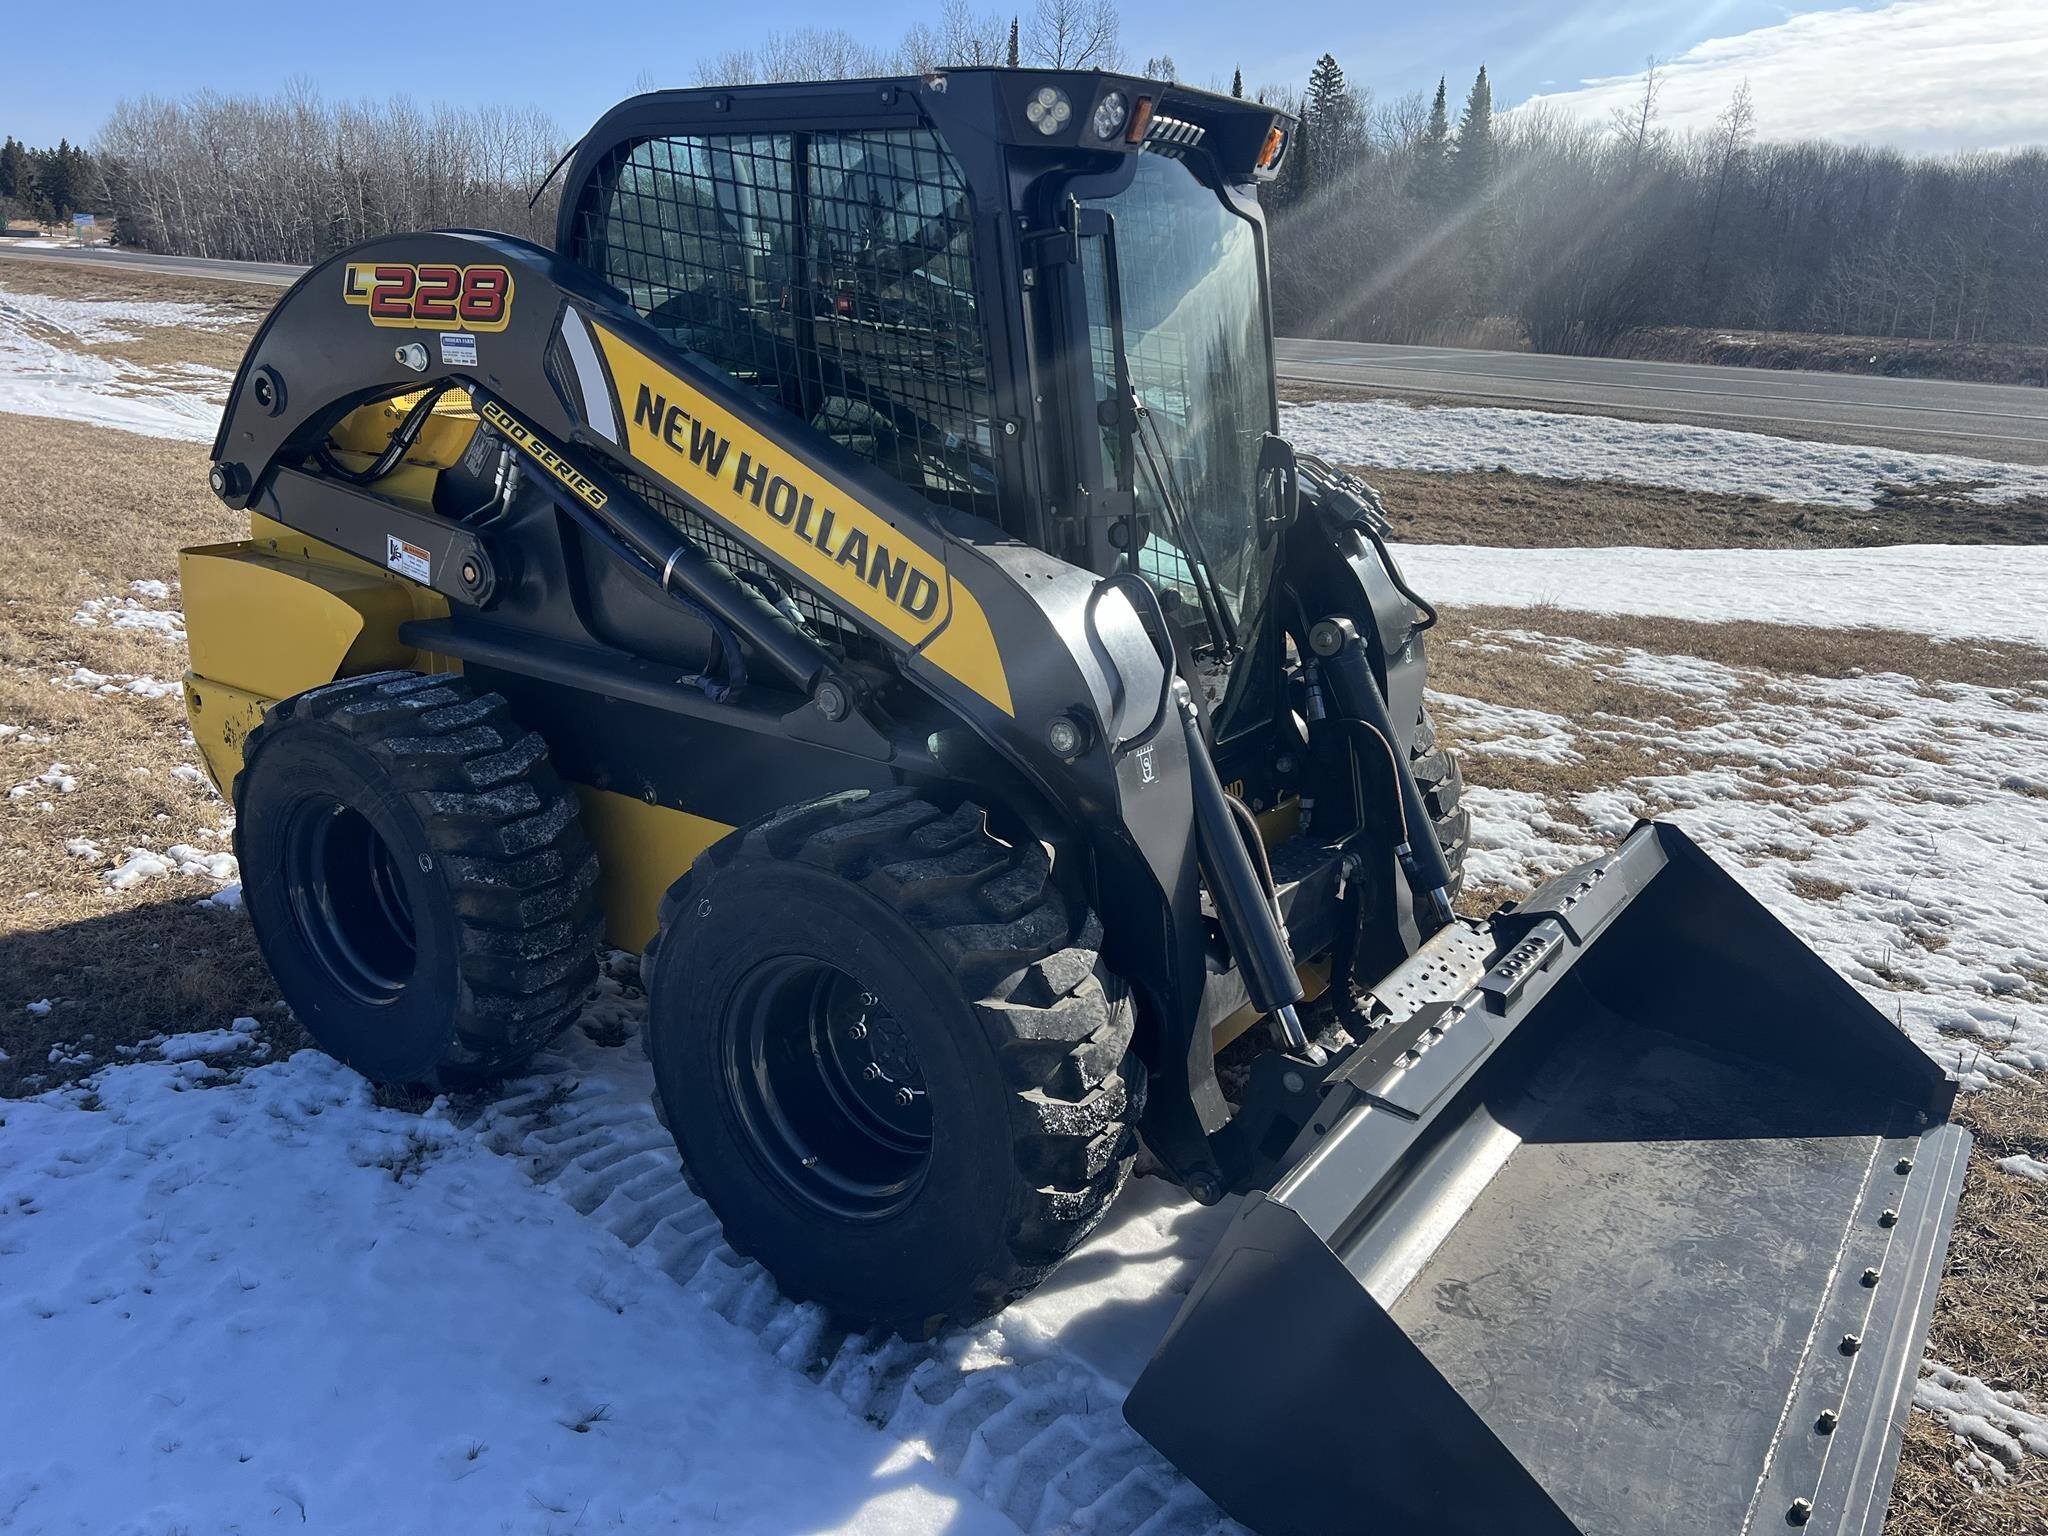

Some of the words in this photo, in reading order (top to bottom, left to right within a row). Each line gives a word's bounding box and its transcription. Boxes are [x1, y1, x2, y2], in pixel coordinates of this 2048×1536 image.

[483, 401, 529, 441] 200
[527, 440, 606, 505] SERIES
[633, 383, 731, 479] NEW
[733, 450, 940, 622] HOLLAND
